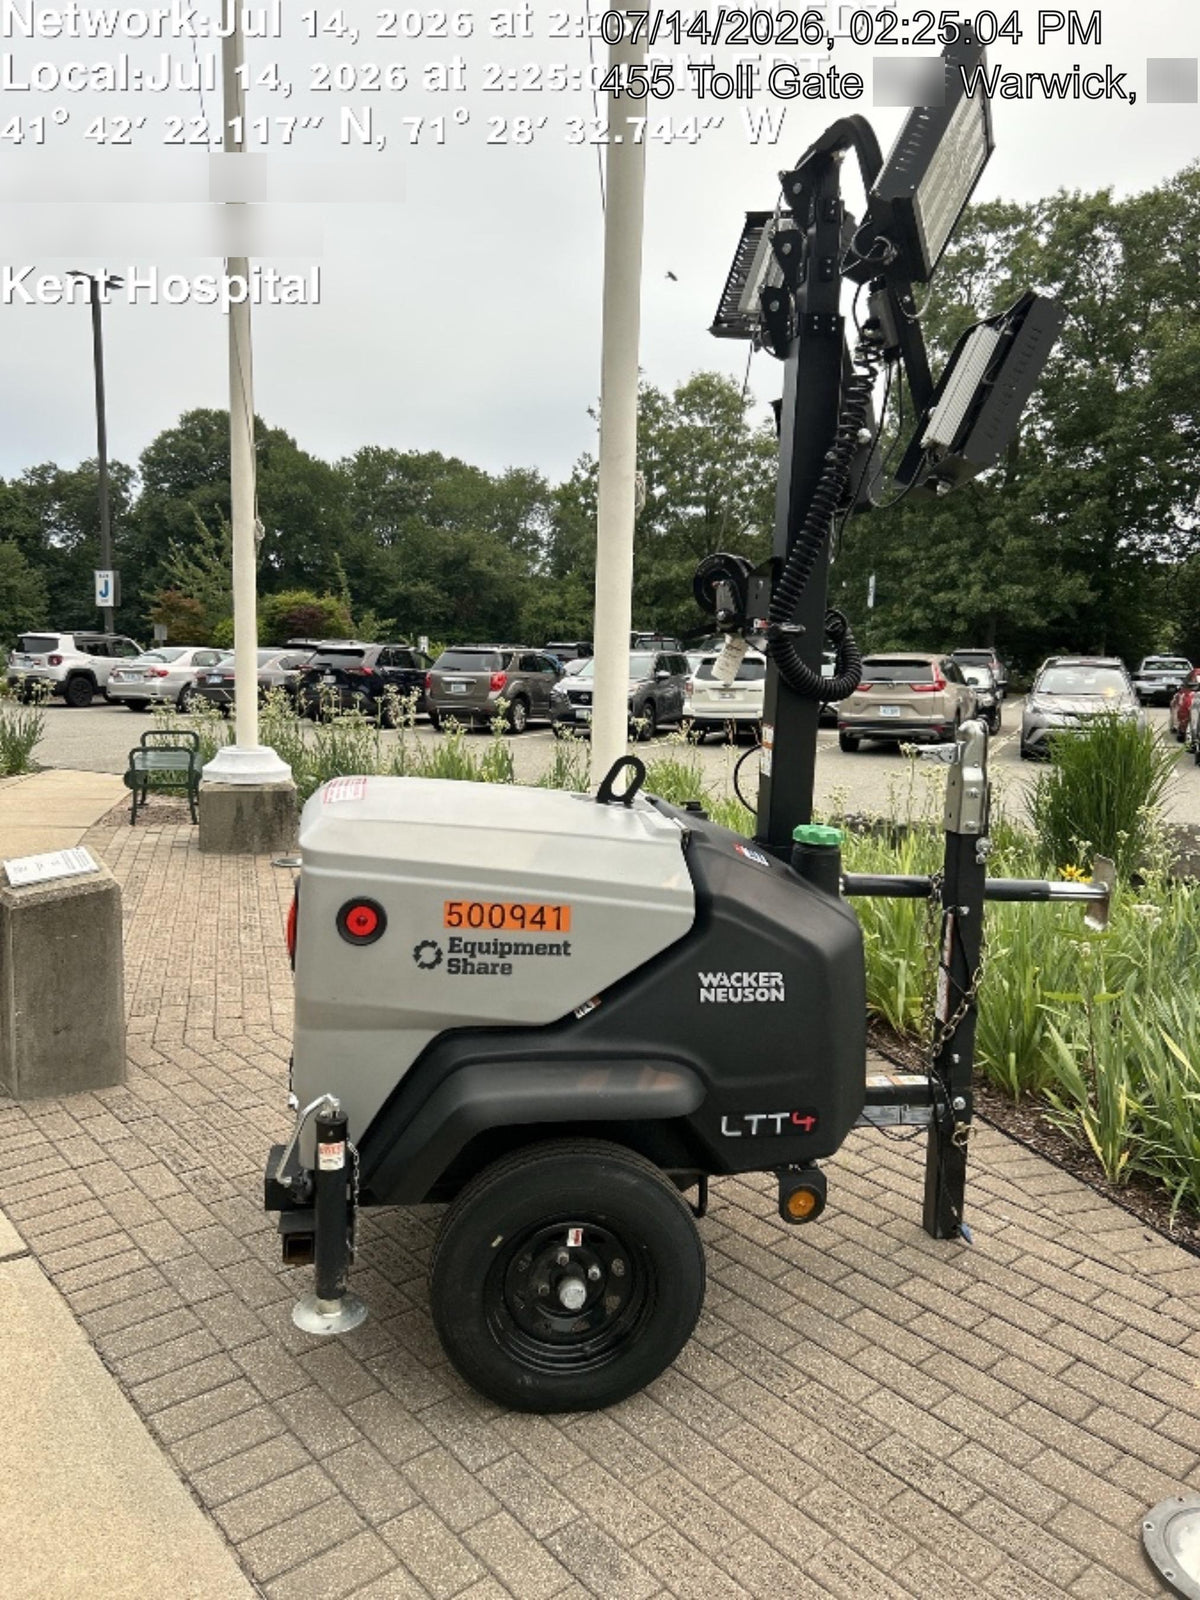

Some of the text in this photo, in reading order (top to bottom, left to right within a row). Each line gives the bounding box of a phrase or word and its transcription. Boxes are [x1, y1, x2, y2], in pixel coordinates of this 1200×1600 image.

[99, 579, 109, 598] J
[446, 902, 564, 931] 500941
[447, 936, 572, 958] Equipment
[447, 957, 513, 976] Share
[698, 972, 785, 988] WACKER
[700, 987, 786, 1003] NEUSON
[721, 1110, 816, 1137] LTT4
